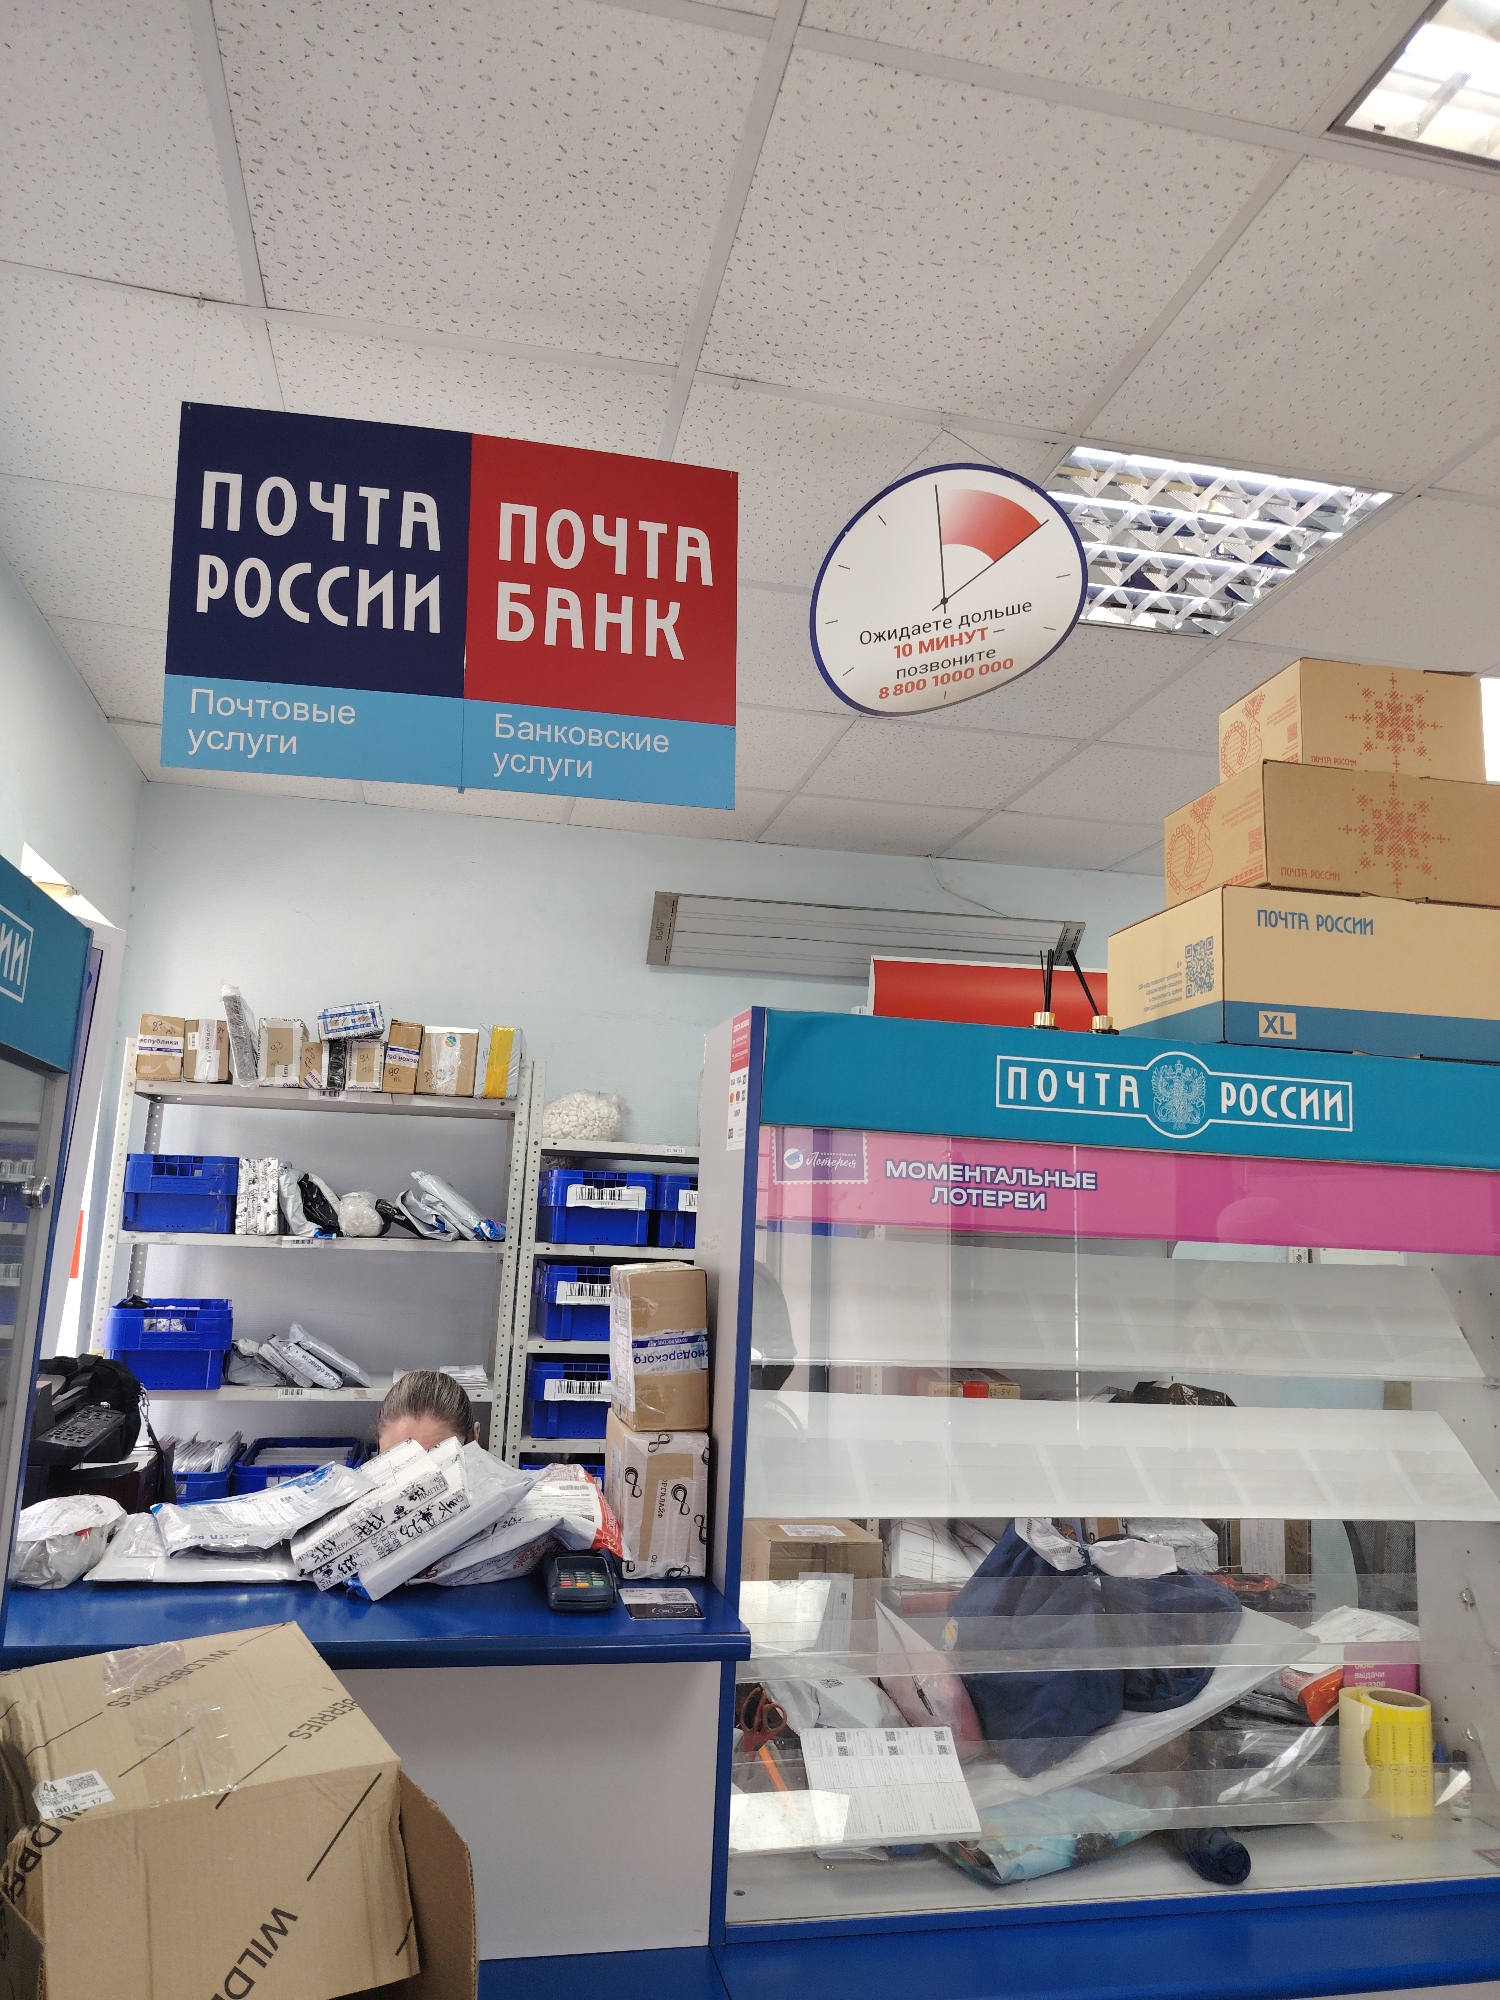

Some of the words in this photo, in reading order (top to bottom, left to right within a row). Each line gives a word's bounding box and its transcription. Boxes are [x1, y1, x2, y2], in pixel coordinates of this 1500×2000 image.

[200, 470, 442, 552] ПОЧТА
[498, 502, 713, 586] ПОЧТА
[195, 553, 441, 634] РОССИИ
[496, 580, 685, 661] БАНК
[859, 617, 953, 645] Ожидаете
[958, 601, 1032, 629] дольше
[893, 643, 913, 659] 10
[918, 627, 989, 654] МИНУТ
[878, 686, 890, 700] 8
[893, 678, 927, 695] 800
[932, 667, 975, 687] 1000
[979, 657, 1014, 676] 000
[896, 648, 997, 679] позвоните
[189, 688, 356, 725] Почтовые
[187, 726, 298, 759] услуги
[494, 713, 670, 753] Банковские
[492, 749, 594, 780] услуги
[1280, 866, 1308, 880] ПОЧТА
[1311, 868, 1340, 882] РОССИИ
[1257, 909, 1310, 931] ПОЧТА
[1316, 914, 1374, 936] РОССИИ
[1262, 1014, 1293, 1036] XL
[1006, 1066, 1140, 1109] ПОЧТА
[1220, 1082, 1344, 1123] РОССИИ
[806, 1151, 857, 1171] Лотерея
[885, 1159, 1098, 1191] МОМЕНТАЛЬНЫЕ
[929, 1185, 1048, 1212] ЛОТЕРЕИ
[106, 1649, 238, 1709] WILDBERRIES
[1354, 1672, 1386, 1680] выдачи
[288, 1698, 359, 1740] BERRIES
